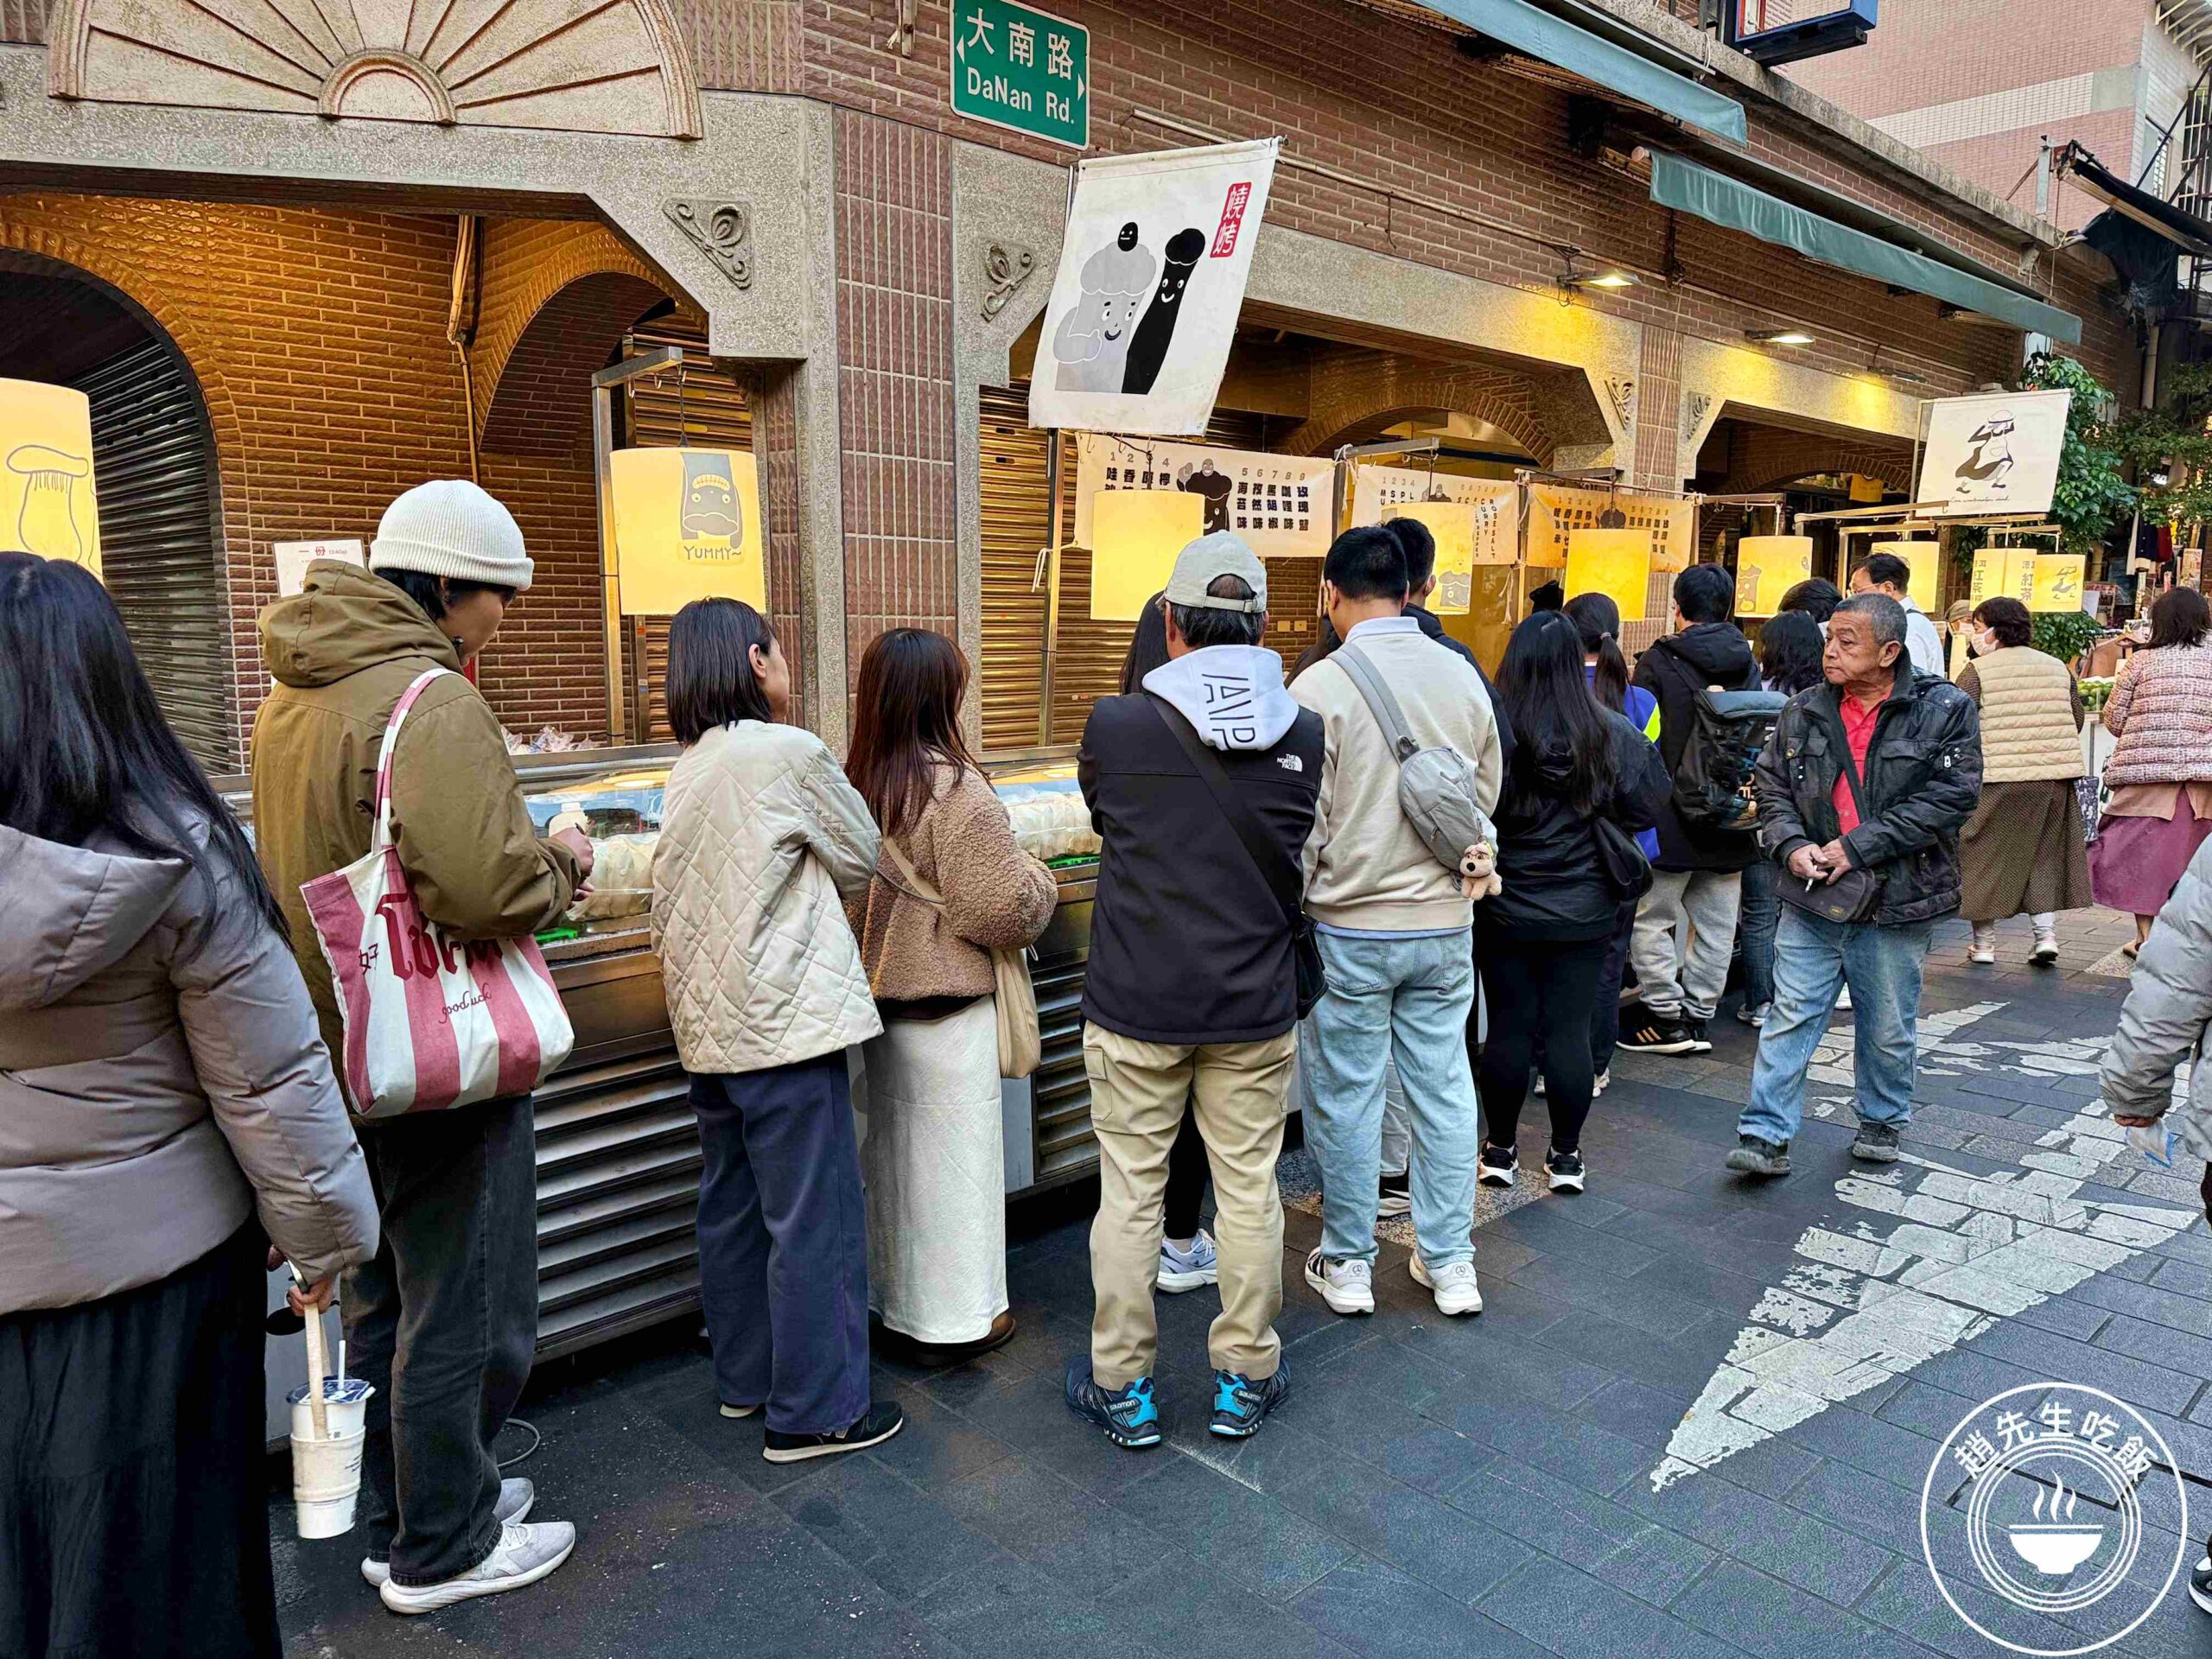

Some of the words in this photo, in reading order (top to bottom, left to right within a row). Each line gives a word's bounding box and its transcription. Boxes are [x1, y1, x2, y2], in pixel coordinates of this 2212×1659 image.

[967, 8, 1074, 80] 大南路
[967, 67, 1033, 111] DaNan
[1046, 91, 1075, 124] Rd.
[1213, 184, 1249, 255] 燒烤
[1110, 452, 1116, 461] 1
[1127, 453, 1135, 463] 2
[1161, 457, 1170, 467] 4
[1242, 467, 1248, 476] 5
[1257, 468, 1263, 477] 6
[1272, 470, 1278, 479] 7
[1285, 472, 1292, 480] 8
[1236, 481, 1249, 530] 海苔味
[1251, 483, 1263, 530] 孜然味
